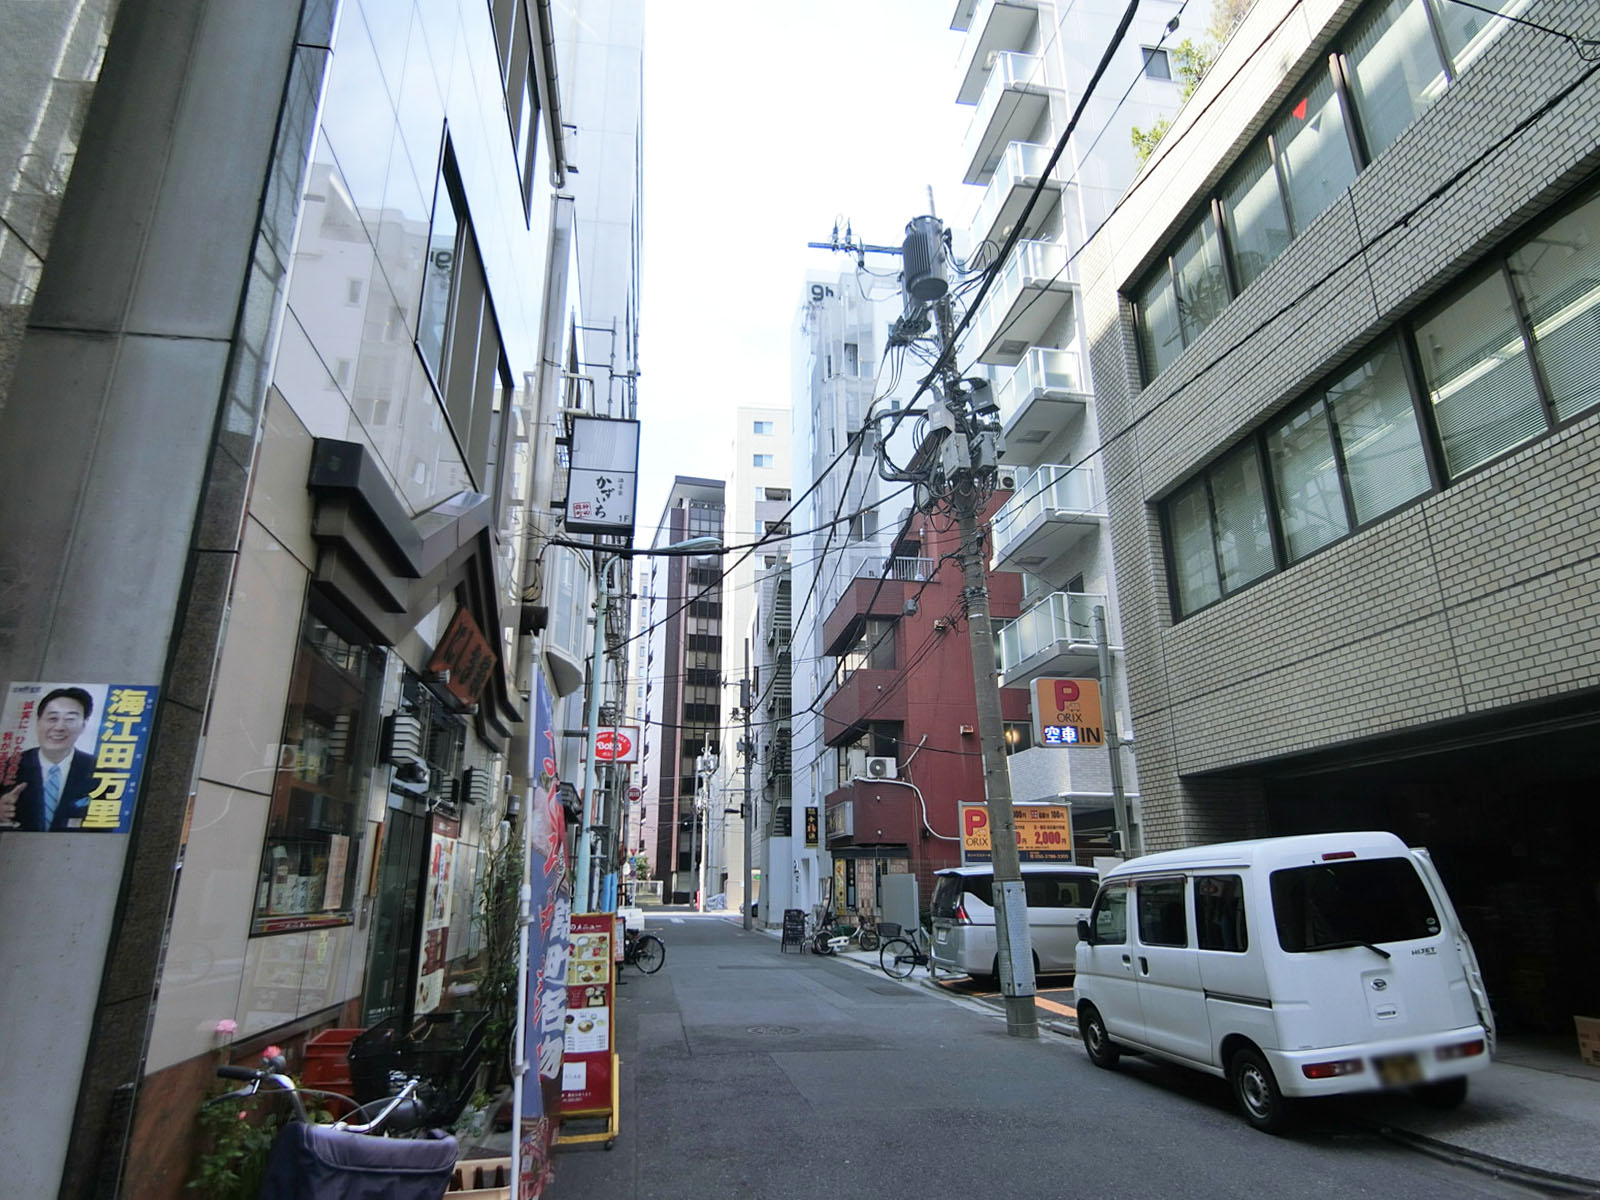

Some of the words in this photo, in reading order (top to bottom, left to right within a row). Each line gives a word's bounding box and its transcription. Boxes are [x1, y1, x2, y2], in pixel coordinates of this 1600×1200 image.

[811, 284, 834, 302] 9h
[618, 514, 630, 523] 1F
[1054, 680, 1080, 712] P
[1056, 713, 1083, 723] ORIX
[1044, 725, 1078, 744] 空車
[1081, 727, 1101, 743] IN
[81, 688, 149, 829] 海江田万里
[964, 809, 987, 837] P
[965, 838, 989, 847] ORIX
[1411, 946, 1436, 956] HIJET
